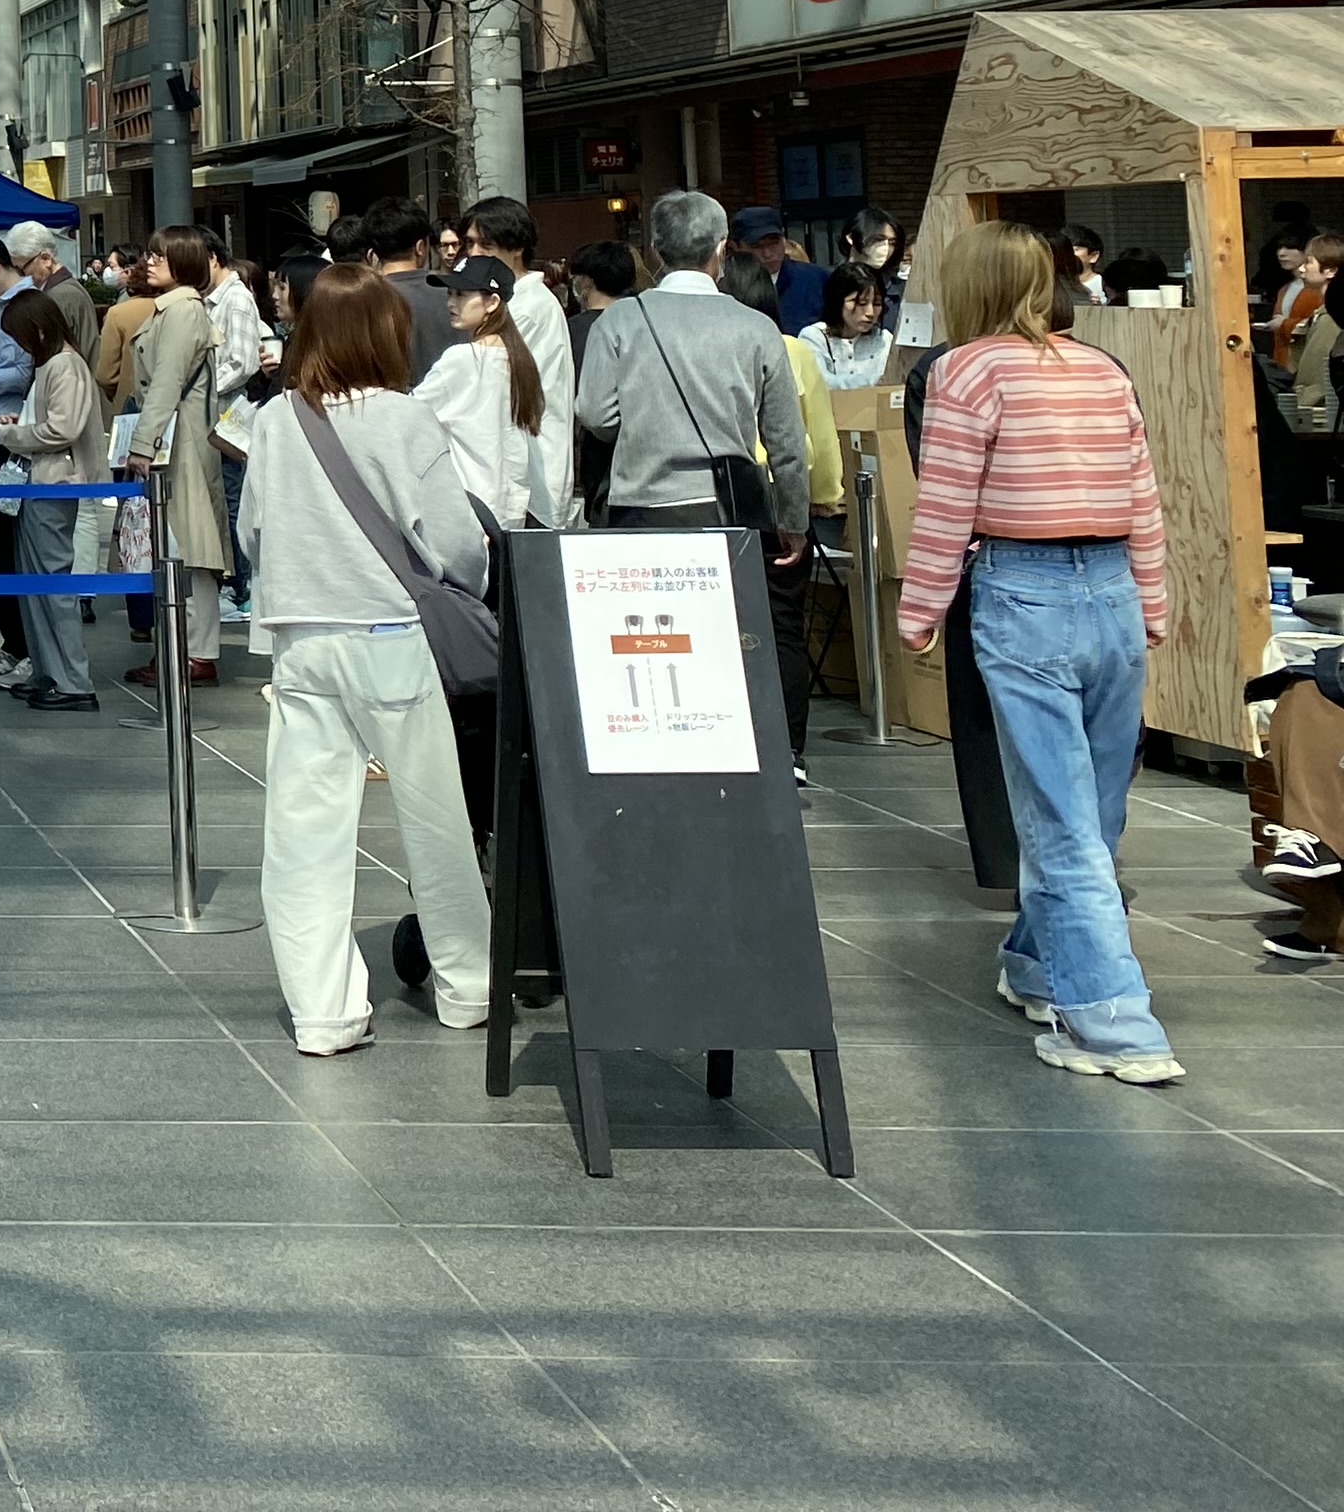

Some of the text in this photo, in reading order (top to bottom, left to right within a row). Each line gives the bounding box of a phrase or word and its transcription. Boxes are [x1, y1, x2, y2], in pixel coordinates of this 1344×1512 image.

[635, 640, 668, 649] テーブル
[665, 713, 733, 721] ドリップコーヒー
